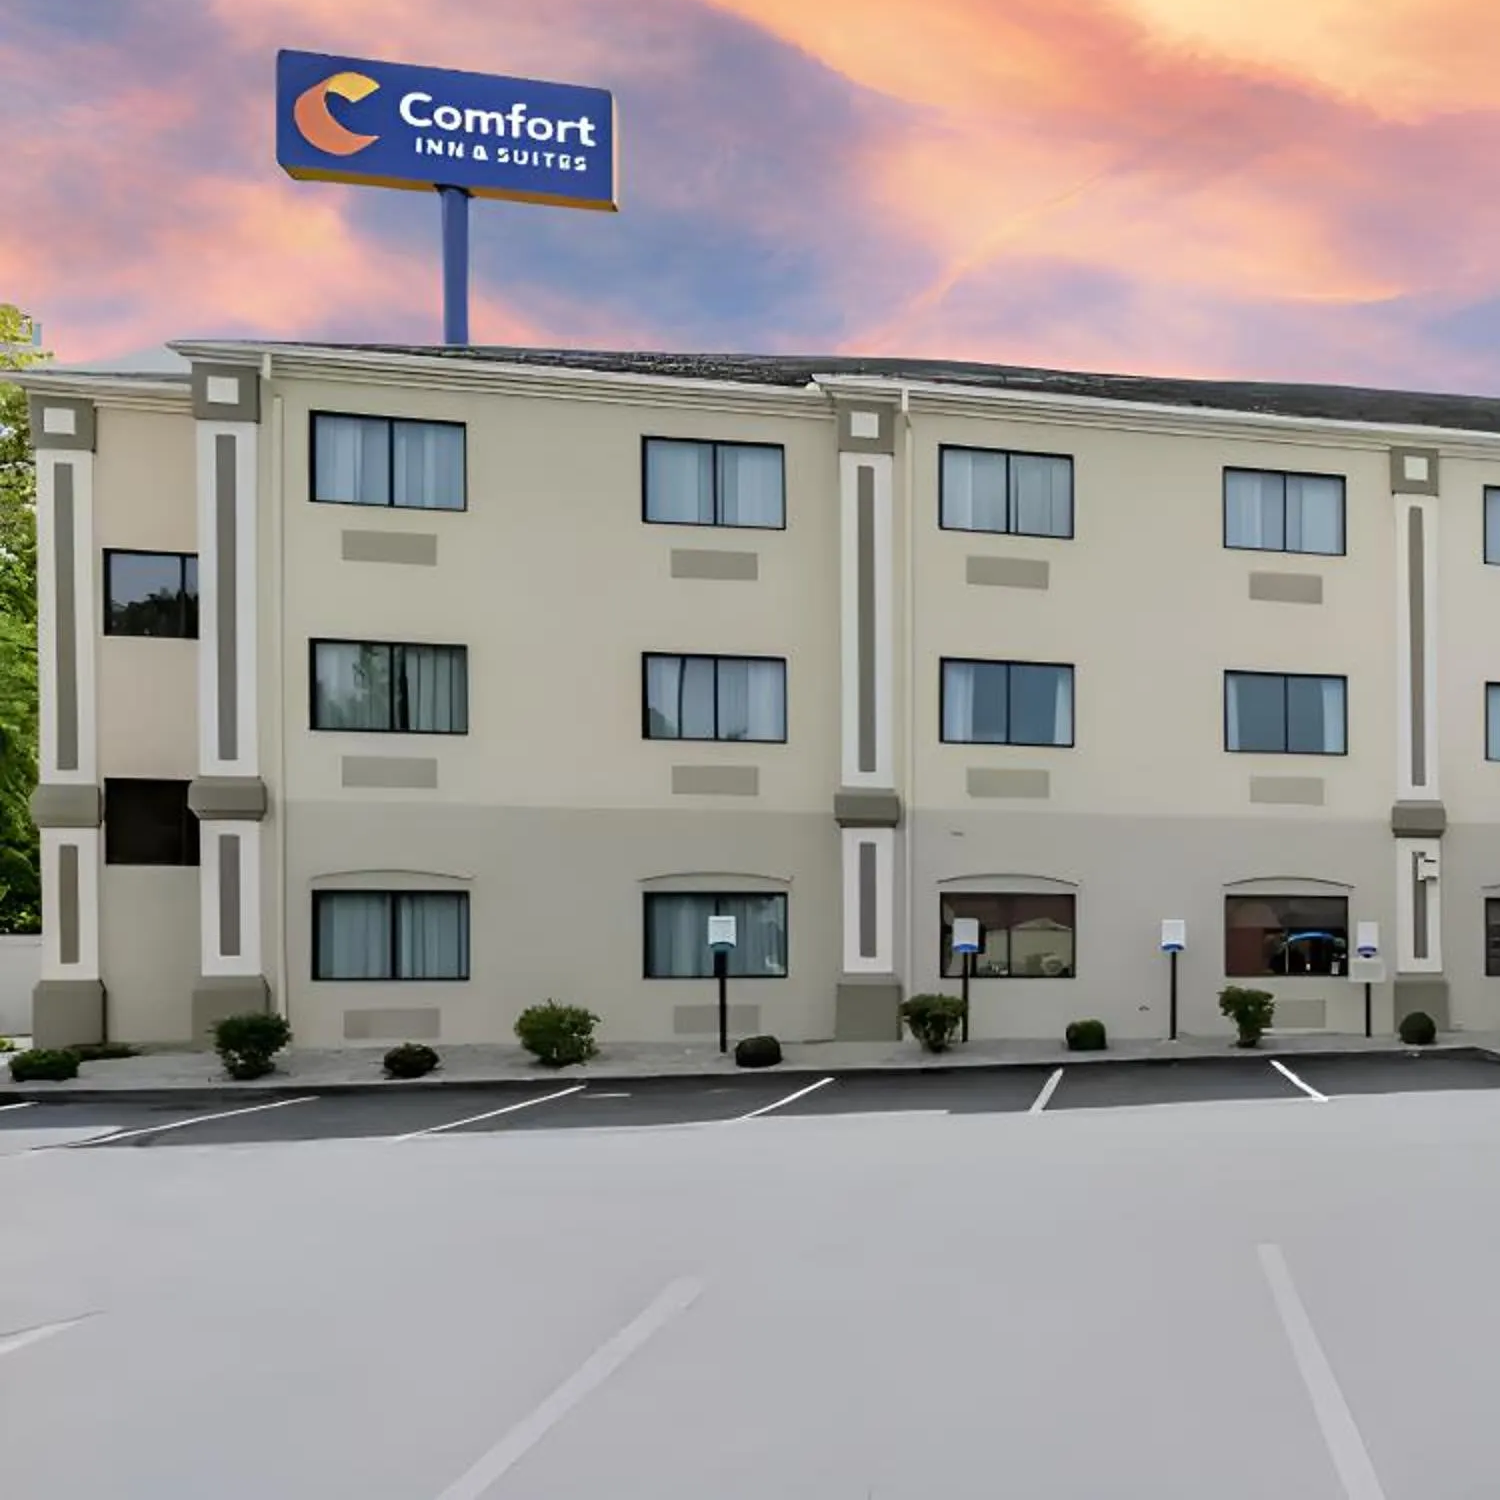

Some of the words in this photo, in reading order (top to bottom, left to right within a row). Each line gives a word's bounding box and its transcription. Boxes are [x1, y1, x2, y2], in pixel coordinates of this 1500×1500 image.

[399, 92, 597, 147] Comfort
[415, 136, 465, 160] INN
[497, 146, 588, 171] SUITES
